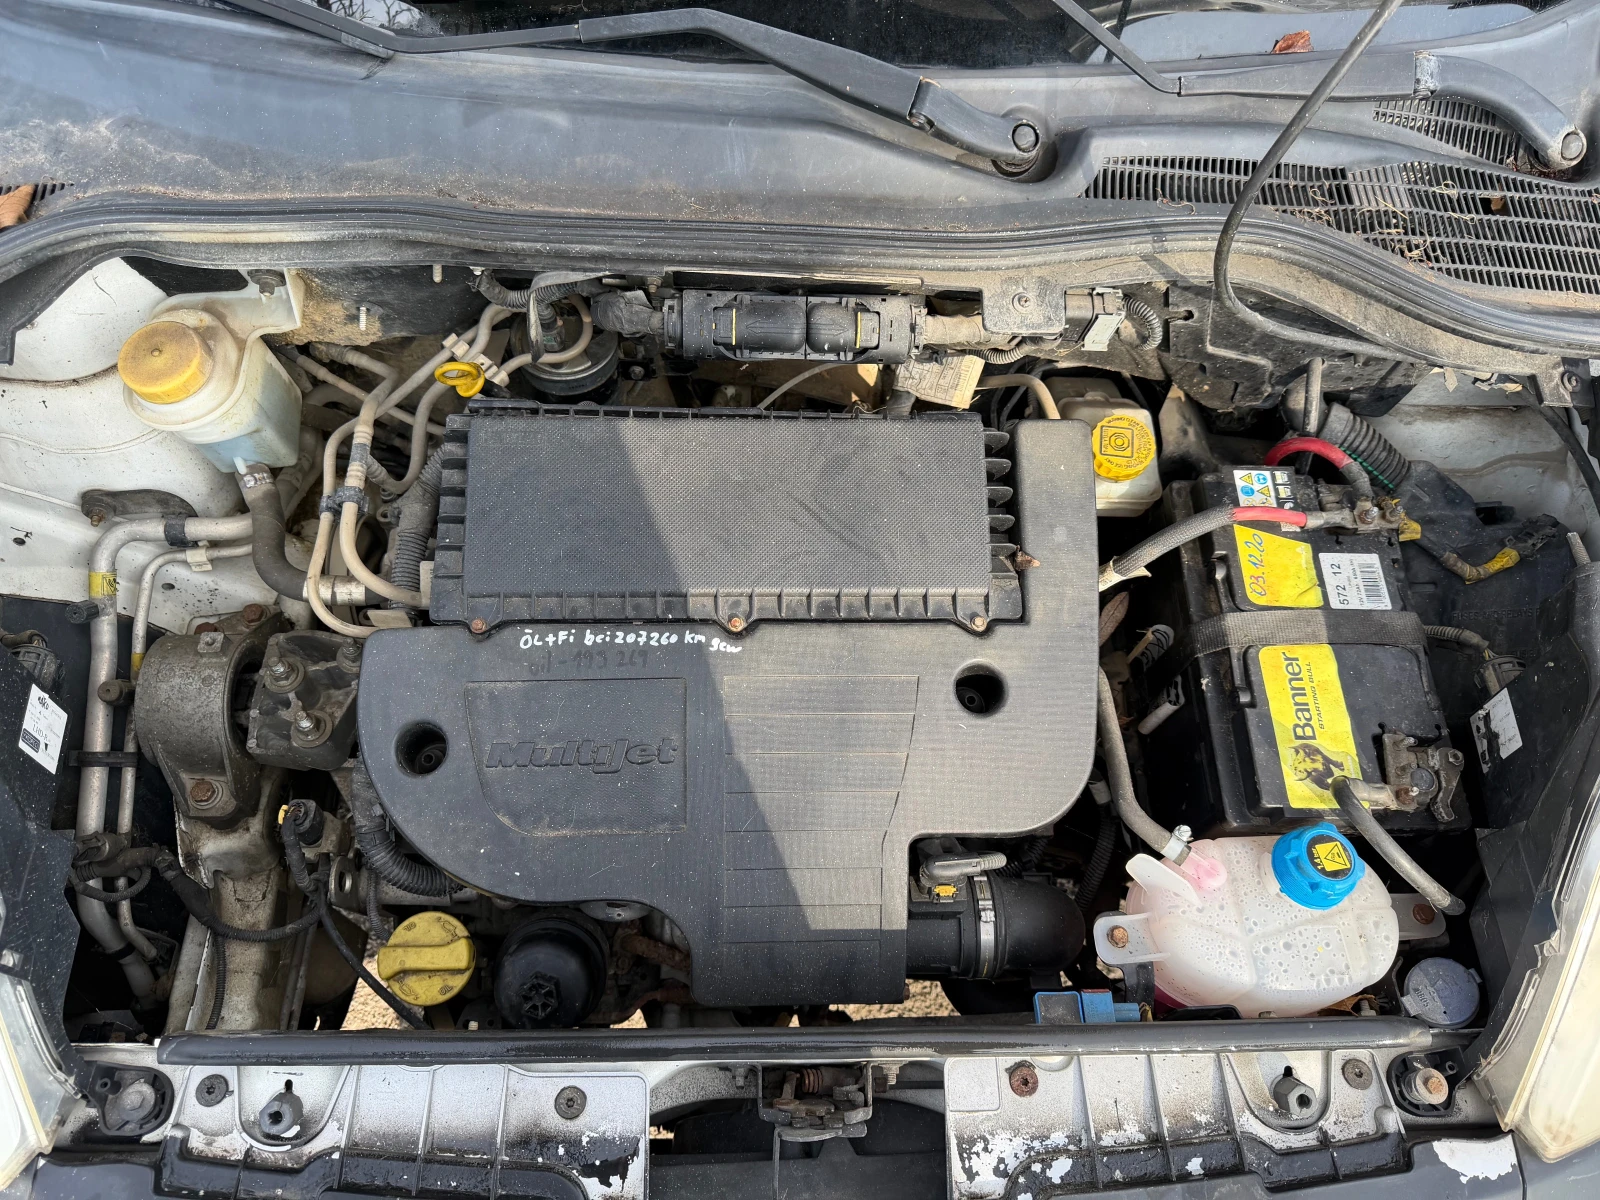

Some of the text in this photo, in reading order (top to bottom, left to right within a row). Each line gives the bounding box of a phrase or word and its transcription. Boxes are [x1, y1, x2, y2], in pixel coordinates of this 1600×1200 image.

[1331, 563, 1342, 577] 12
[1335, 584, 1350, 606] 572
[684, 629, 706, 644] km
[1281, 651, 1318, 741] Banner
[1305, 661, 1325, 730] STARTING BULL
[486, 738, 679, 775] MultiJet
[402, 921, 417, 932] OIL
[439, 984, 454, 996] OIL
